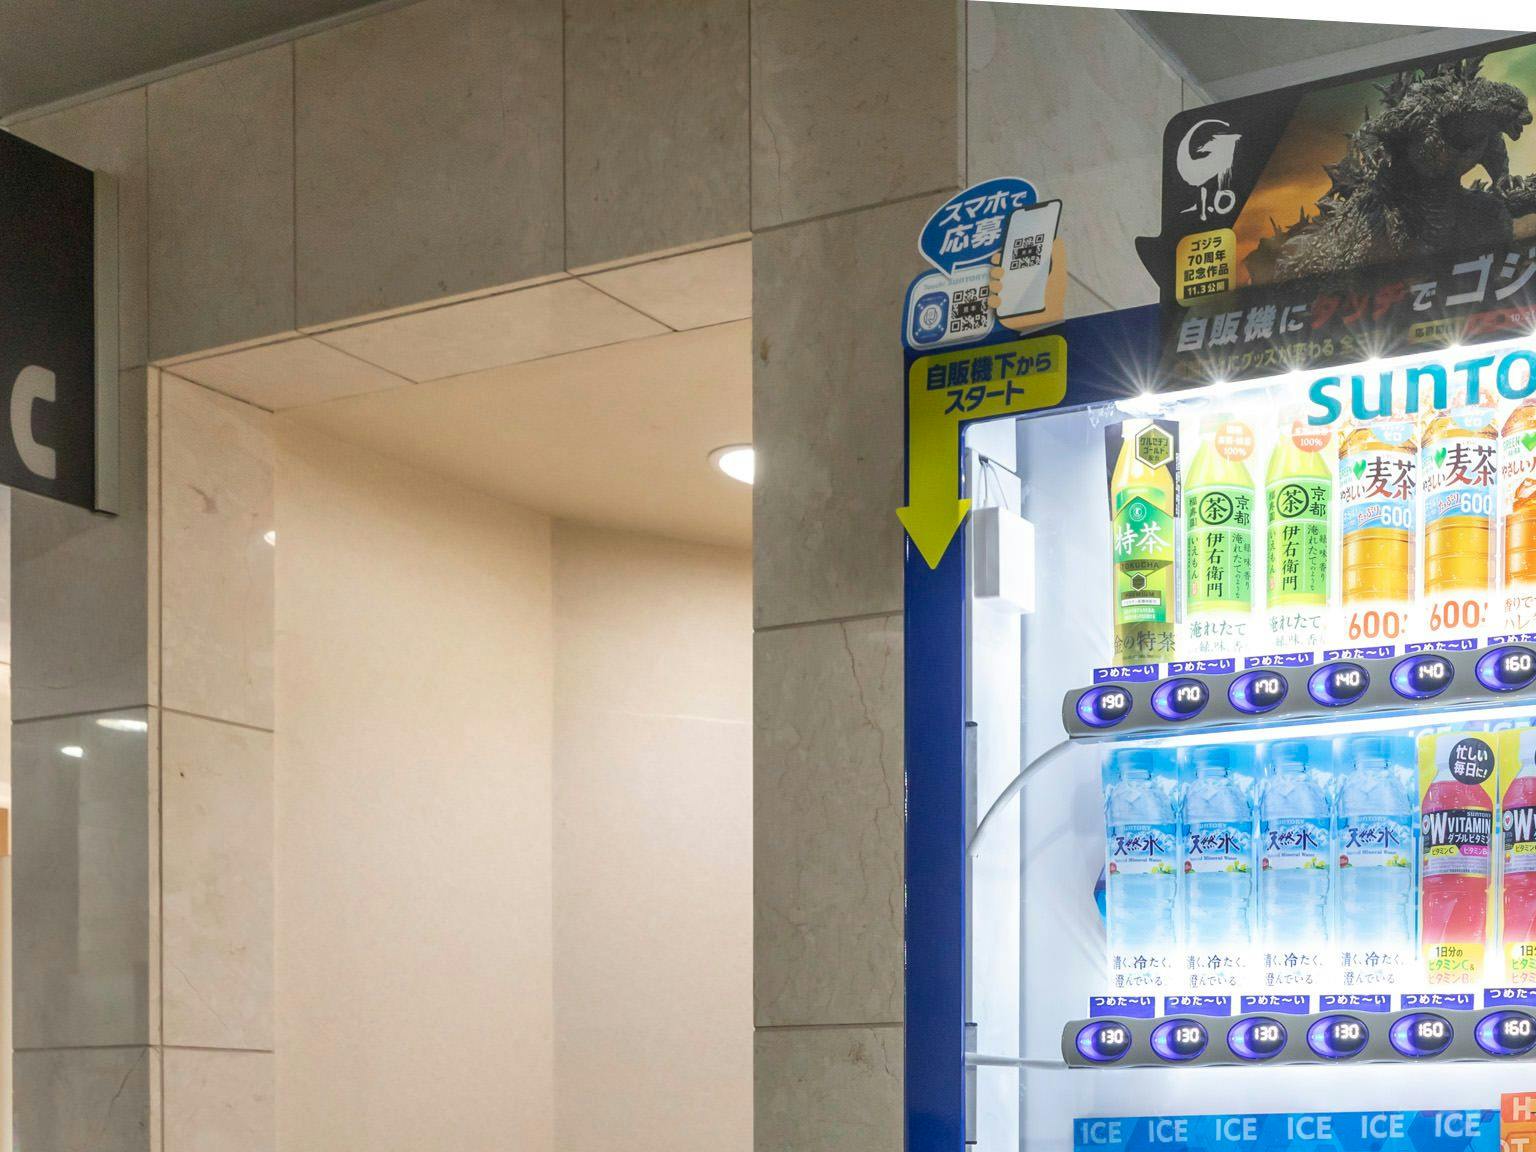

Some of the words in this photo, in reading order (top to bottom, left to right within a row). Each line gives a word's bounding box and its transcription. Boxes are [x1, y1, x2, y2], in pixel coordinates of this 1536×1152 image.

[938, 190, 1028, 227] スマホで
[939, 215, 1005, 256] 応募
[1191, 236, 1222, 252] ゴジラ
[1187, 251, 1226, 266] 70周年
[1184, 264, 1229, 282] 記念作品
[926, 352, 1052, 391] 自販機下から
[944, 380, 1025, 415] スタート
[1300, 437, 1323, 447] 100%
[1233, 495, 1250, 526] 京都
[1309, 486, 1327, 517] 京都
[1115, 522, 1170, 556] 特茶
[1206, 532, 1224, 598] 伊右衛門
[1282, 525, 1300, 591] 伊右衛門
[1114, 632, 1176, 653] 金の特茶
[1103, 693, 1124, 708] 190
[1177, 686, 1200, 700] 170
[1456, 744, 1488, 762] 忙しい
[1454, 760, 1487, 778] 毎日に!
[1447, 817, 1491, 834] VITAMIN
[1114, 835, 1165, 857] 天然水
[1189, 833, 1240, 855] 天然水
[1266, 830, 1318, 852] 天然水
[1346, 827, 1400, 849] 天然水
[1435, 945, 1463, 958] 1日分の
[1102, 1029, 1123, 1044] 130
[1082, 1120, 1121, 1144] ICE
[1148, 1119, 1188, 1143] ICE
[1215, 1118, 1257, 1141] ICE
[1288, 1116, 1332, 1140] ICE
[1361, 1115, 1404, 1139] ICE
[1434, 1113, 1481, 1137] ICE
